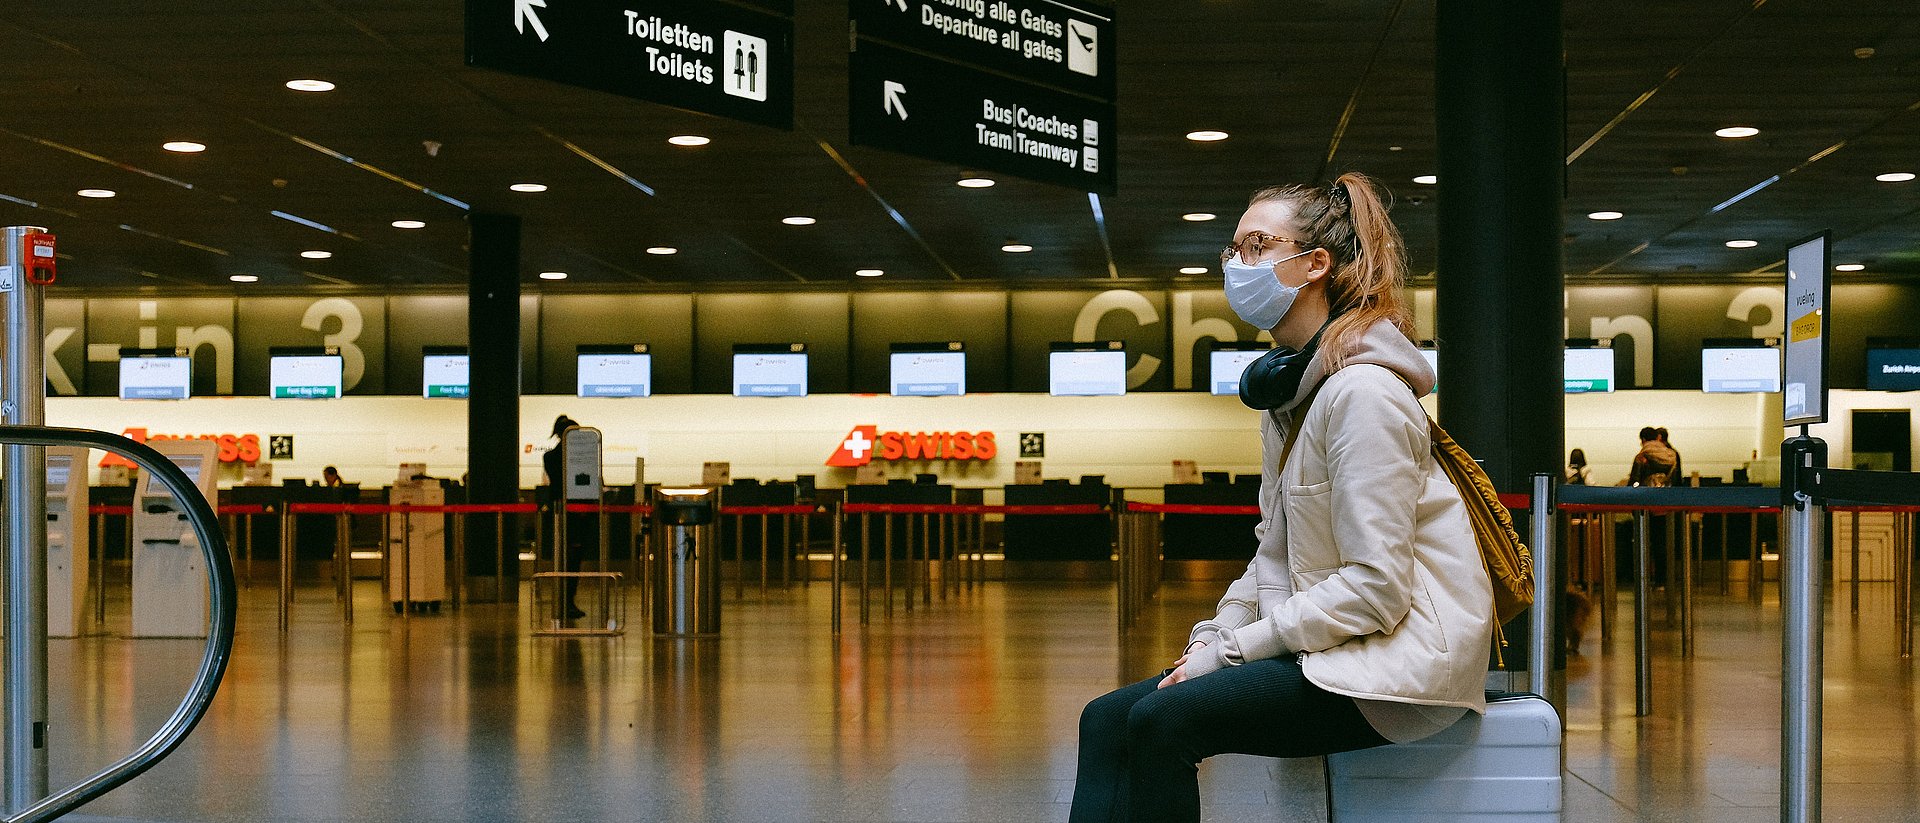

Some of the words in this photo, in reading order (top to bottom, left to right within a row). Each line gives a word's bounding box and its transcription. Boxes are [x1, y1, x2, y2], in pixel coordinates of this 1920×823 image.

[624, 9, 713, 54] Toiletten
[921, 4, 998, 45] Departure
[1001, 30, 1020, 51] all
[1023, 39, 1063, 63] gates
[989, 1, 1017, 25] alle
[1020, 8, 1062, 38] Gates
[645, 46, 713, 85] Toilets
[301, 297, 366, 392] 3
[880, 430, 998, 461] SWISS
